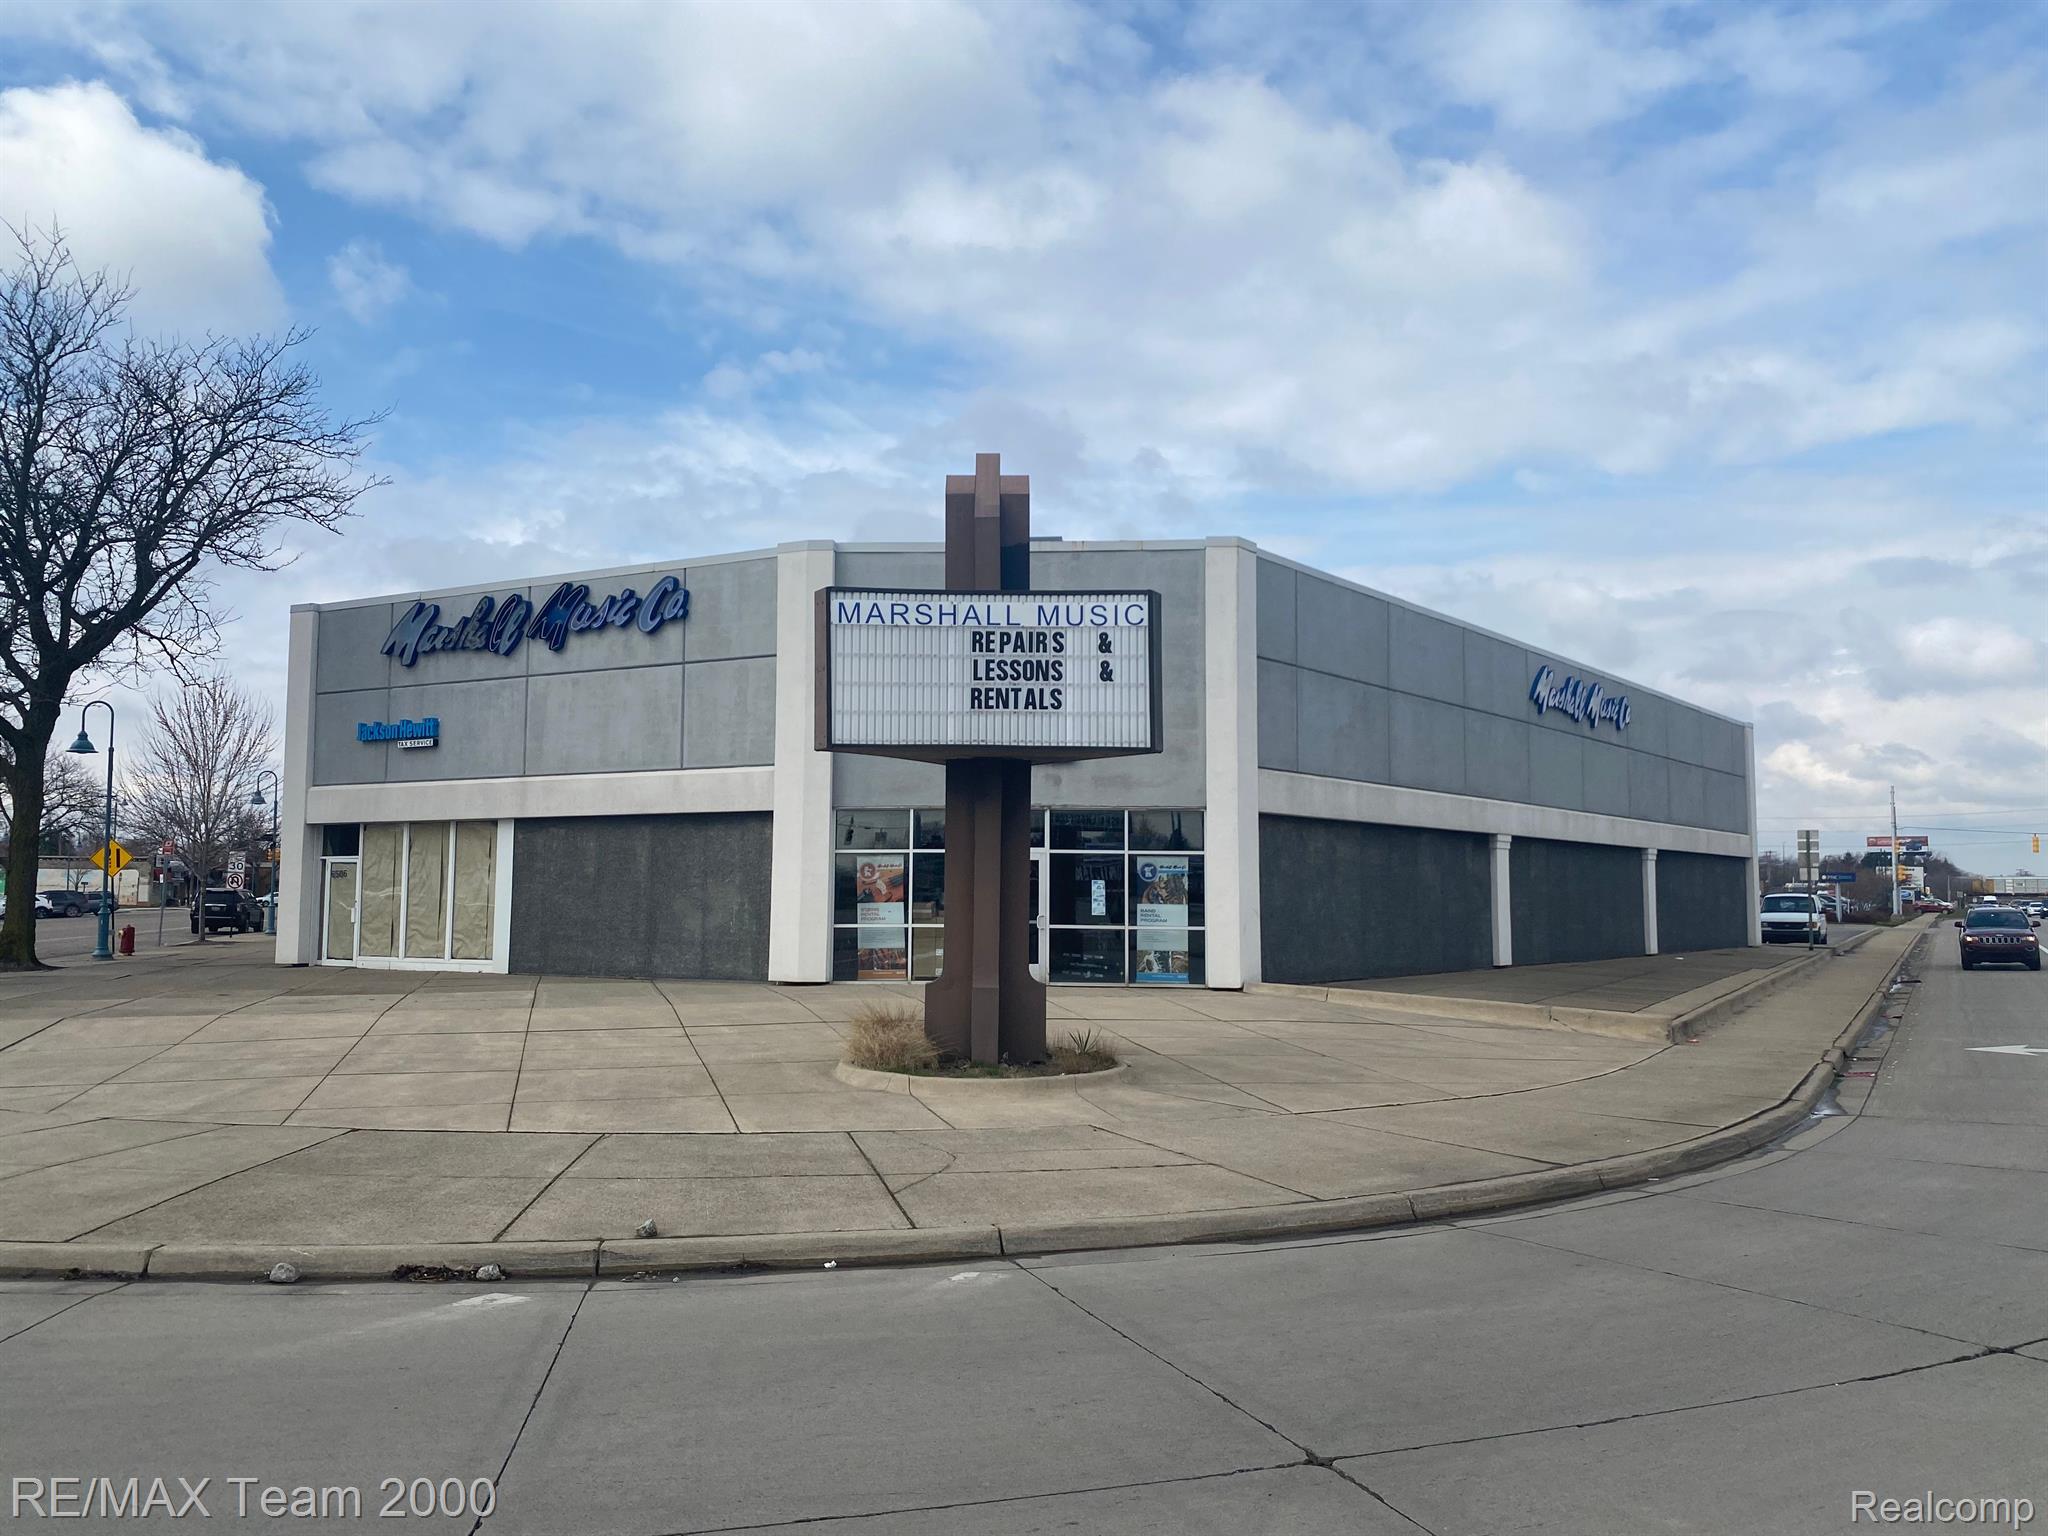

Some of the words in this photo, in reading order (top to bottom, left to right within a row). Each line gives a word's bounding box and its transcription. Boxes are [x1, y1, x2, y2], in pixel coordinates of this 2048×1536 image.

[380, 593, 533, 667] Marshall
[527, 582, 642, 651] Music
[636, 575, 690, 634] Co.
[837, 601, 1021, 627] MARSHALL
[1037, 603, 1145, 627] MUSIC
[971, 631, 1065, 654] REPAIRS
[1098, 632, 1113, 654] &
[973, 659, 1064, 682] LESSONS
[1100, 660, 1115, 682] &
[970, 687, 1063, 710] RENTALS
[1529, 665, 1587, 723] Marshall
[1584, 682, 1619, 729] Music
[229, 862, 243, 871] 30
